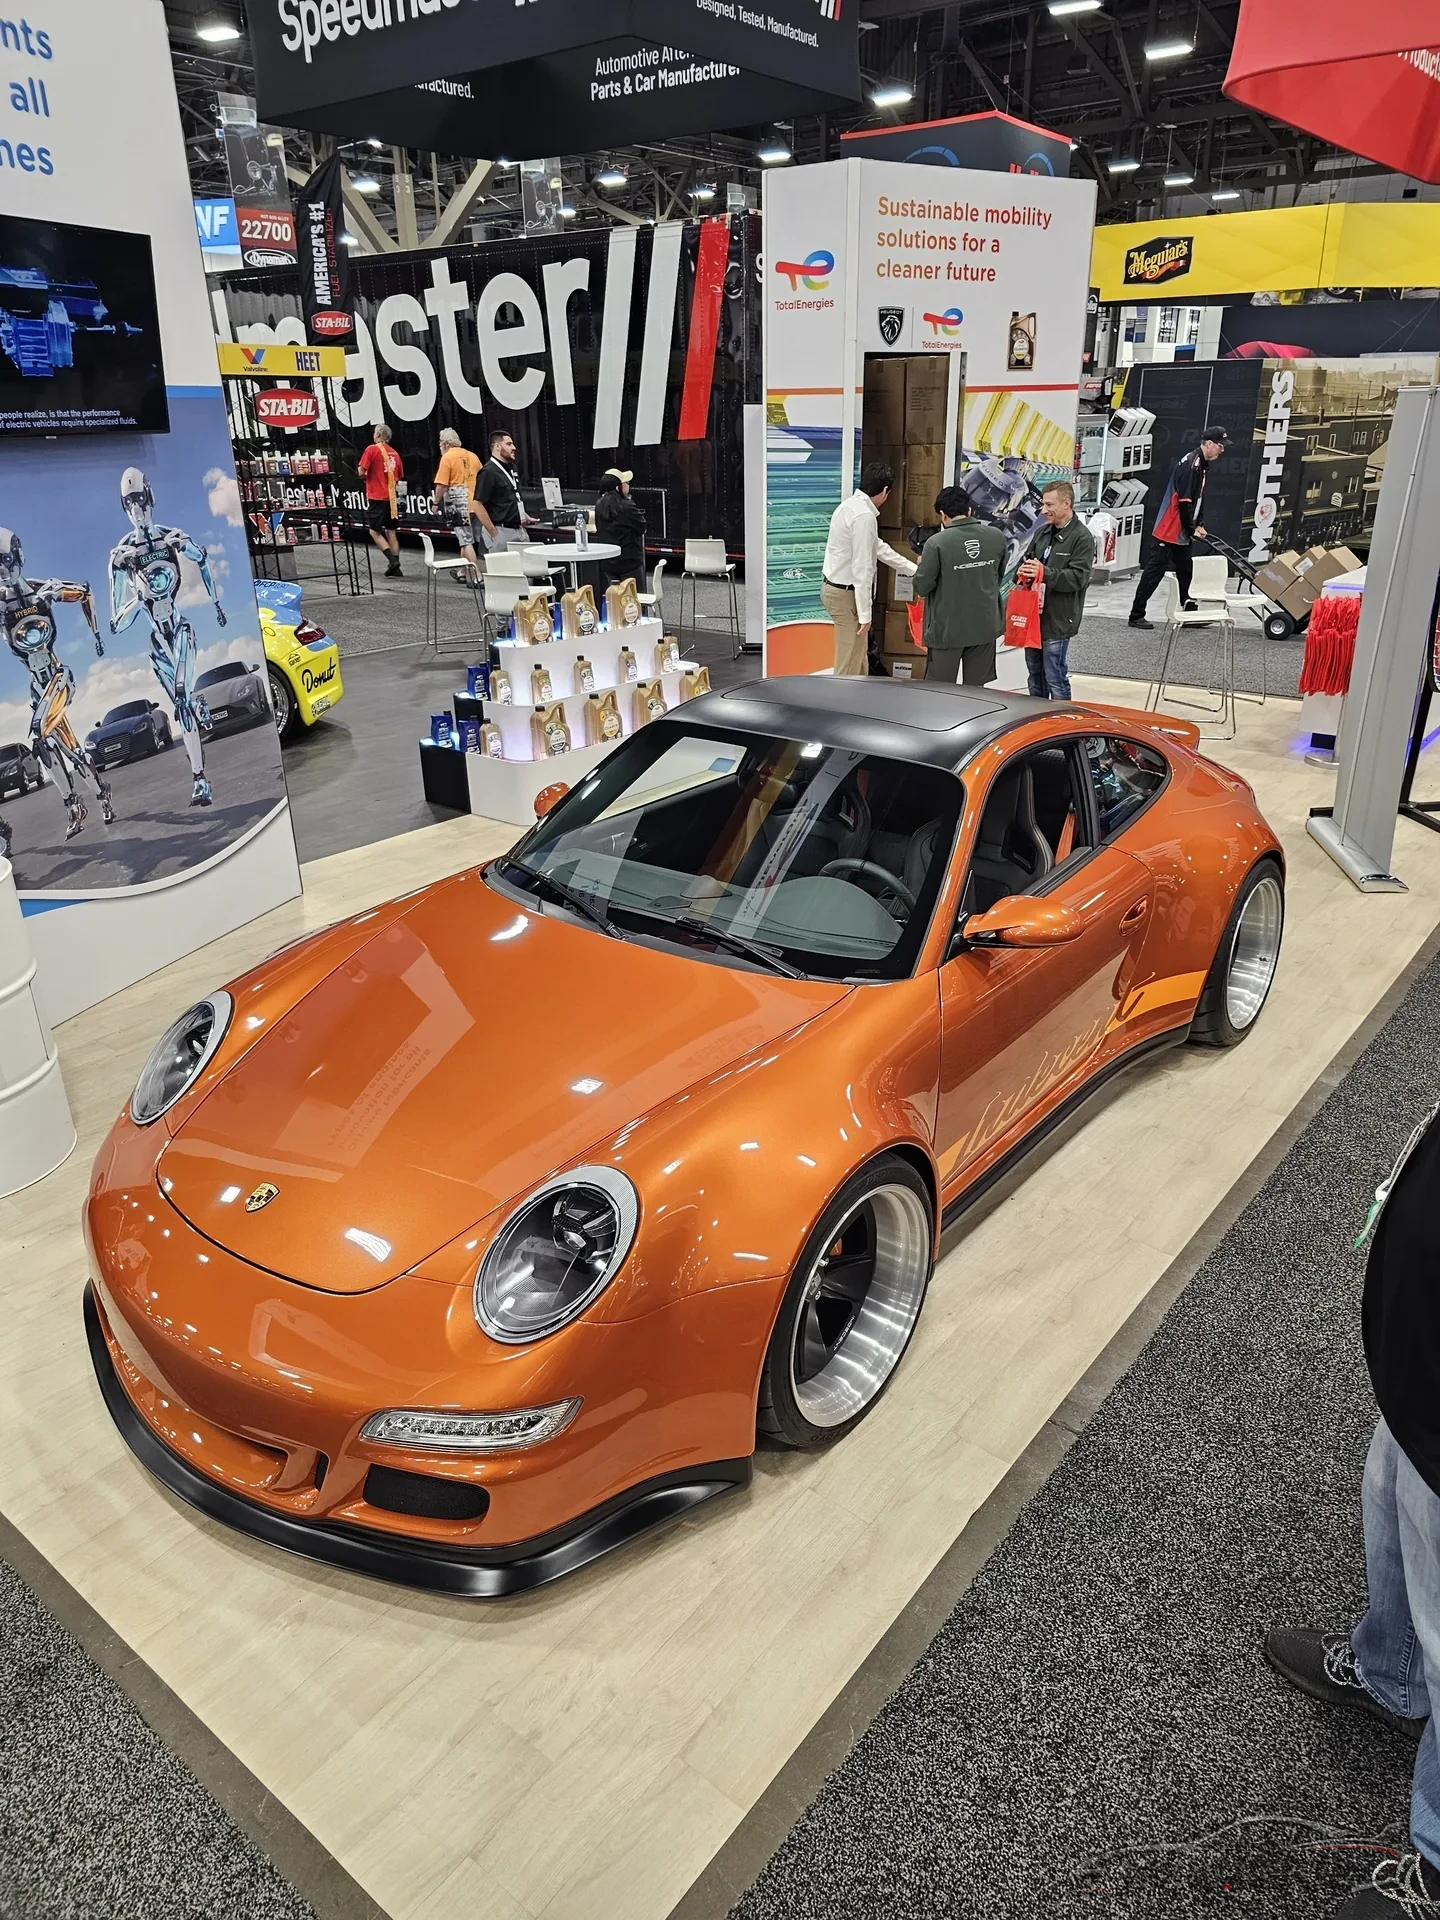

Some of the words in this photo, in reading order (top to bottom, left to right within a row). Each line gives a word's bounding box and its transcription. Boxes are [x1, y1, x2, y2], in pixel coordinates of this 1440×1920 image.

[737, 4, 766, 31] Tested,
[767, 16, 819, 47] Manufactured.
[595, 48, 660, 76] Automotive
[9, 76, 50, 118] all
[590, 76, 621, 101] Parts
[623, 76, 633, 95] &
[635, 73, 656, 93] Car
[308, 201, 325, 221] #1
[878, 196, 979, 222] Sustainable
[985, 206, 1052, 230] mobility
[241, 219, 292, 242] 22700
[877, 228, 957, 251] solutions
[962, 232, 986, 252] for
[991, 238, 1000, 253] a
[311, 224, 332, 305] AMERICA'S
[876, 259, 941, 280] cleaner
[947, 261, 996, 282] future
[1128, 240, 1188, 279] Meguiar's
[331, 275, 341, 297] FUEL
[775, 298, 834, 311] TotalEnergies
[314, 316, 351, 332] STA-BIL
[922, 341, 962, 350] TotalEnergies
[295, 352, 320, 371] HEET
[0, 411, 22, 420] people
[24, 410, 48, 419] realize,
[49, 409, 56, 418] is
[57, 409, 69, 418] that
[71, 409, 81, 417] the
[82, 409, 121, 418] performance
[259, 399, 316, 416] STA-BIL
[6, 420, 31, 428] electric
[33, 419, 60, 428] vehicles
[61, 419, 84, 428] require
[85, 417, 118, 426] specialized
[120, 416, 138, 425] fluids.
[1248, 370, 1294, 563] MOTHERS
[142, 551, 168, 563] ELECTRIC
[953, 559, 996, 571] INDECENT
[14, 605, 39, 619] HYBRID
[302, 657, 336, 694] Donut
